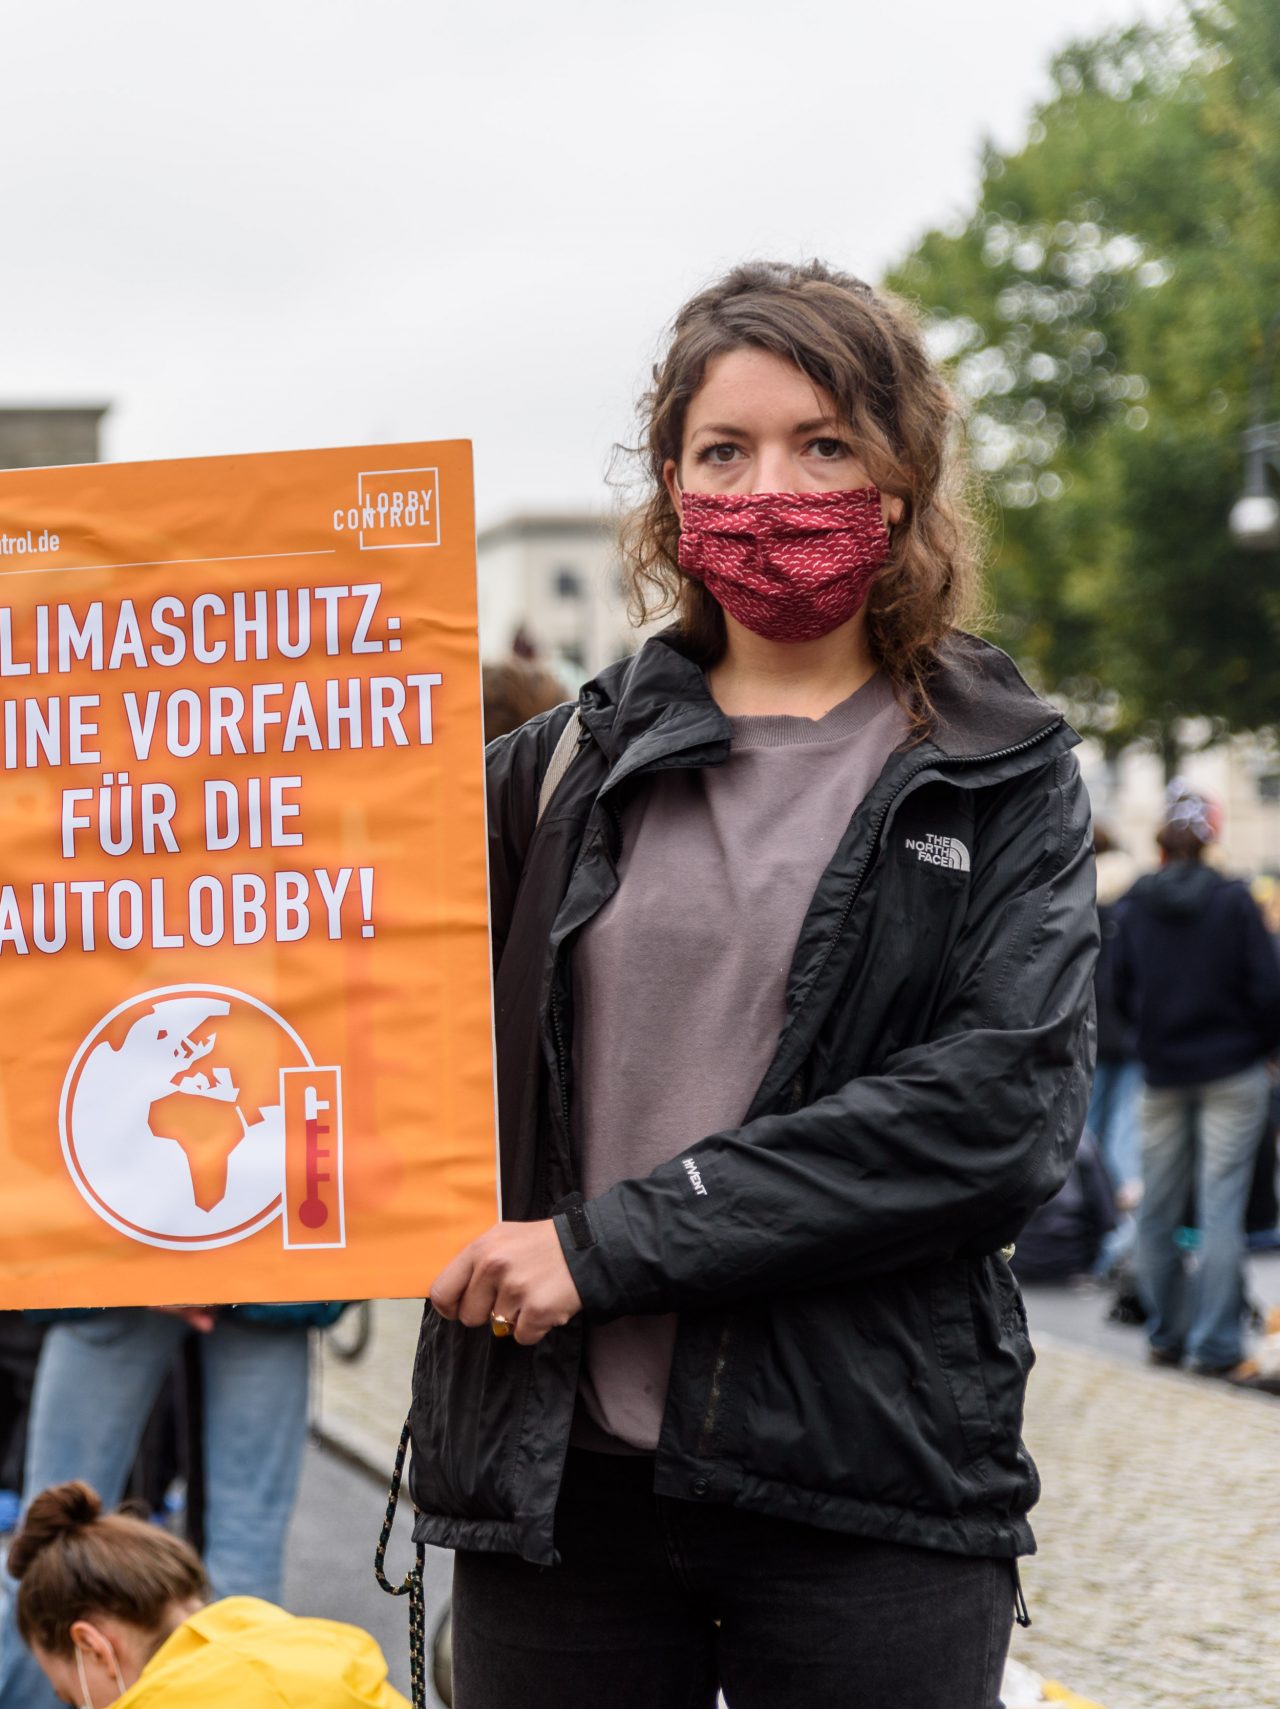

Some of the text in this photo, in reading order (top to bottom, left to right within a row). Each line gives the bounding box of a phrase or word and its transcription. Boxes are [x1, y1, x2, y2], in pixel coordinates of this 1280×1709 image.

[365, 489, 432, 514] LOBBY
[333, 504, 430, 531] CONTROL
[122, 672, 443, 761] VORFAHRT
[60, 771, 304, 858] FÜR DIE
[905, 838, 950, 858] NORTH
[926, 833, 951, 848] THE
[918, 851, 950, 868] FACE
